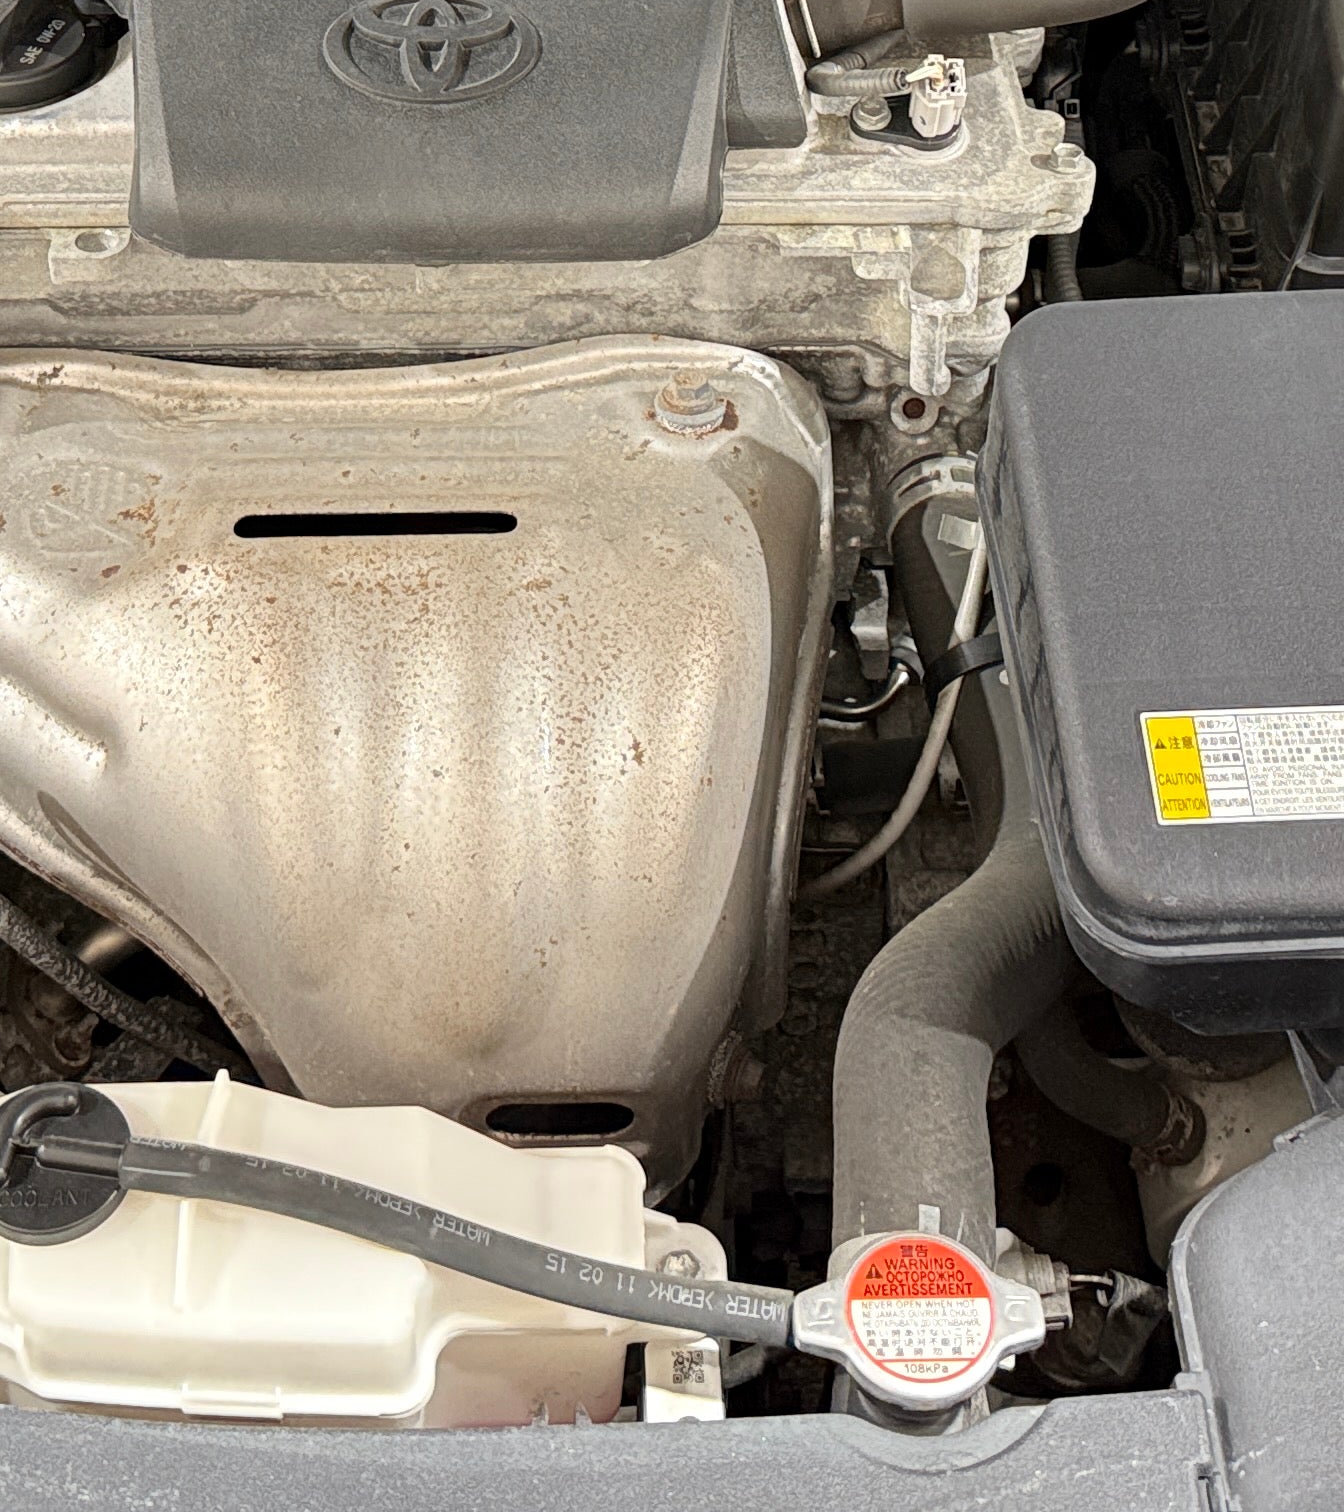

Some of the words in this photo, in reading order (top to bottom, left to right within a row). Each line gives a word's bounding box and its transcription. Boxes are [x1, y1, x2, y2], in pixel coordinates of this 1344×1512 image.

[20, 45, 44, 65] SAE
[36, 19, 67, 45] 0W-20
[1168, 736, 1195, 750] 注意
[1158, 772, 1202, 786] CAUTION
[1163, 797, 1207, 812] ATTENTION
[431, 1211, 491, 1248] WATER
[900, 1245, 929, 1258] 警告
[544, 1251, 567, 1274] 15
[884, 1258, 955, 1271] WARNING
[579, 1262, 604, 1285] 02
[886, 1270, 965, 1284] ОСТОРОЖНО
[617, 1272, 636, 1294] 11
[863, 1282, 973, 1297] AVERTISSEMENT
[725, 1293, 787, 1323] WATER
[862, 1300, 892, 1310] NEVER
[896, 1300, 922, 1309] OPEN
[925, 1300, 953, 1309] WHEN
[956, 1299, 976, 1308] HOT
[904, 1362, 949, 1374] 108kPa
